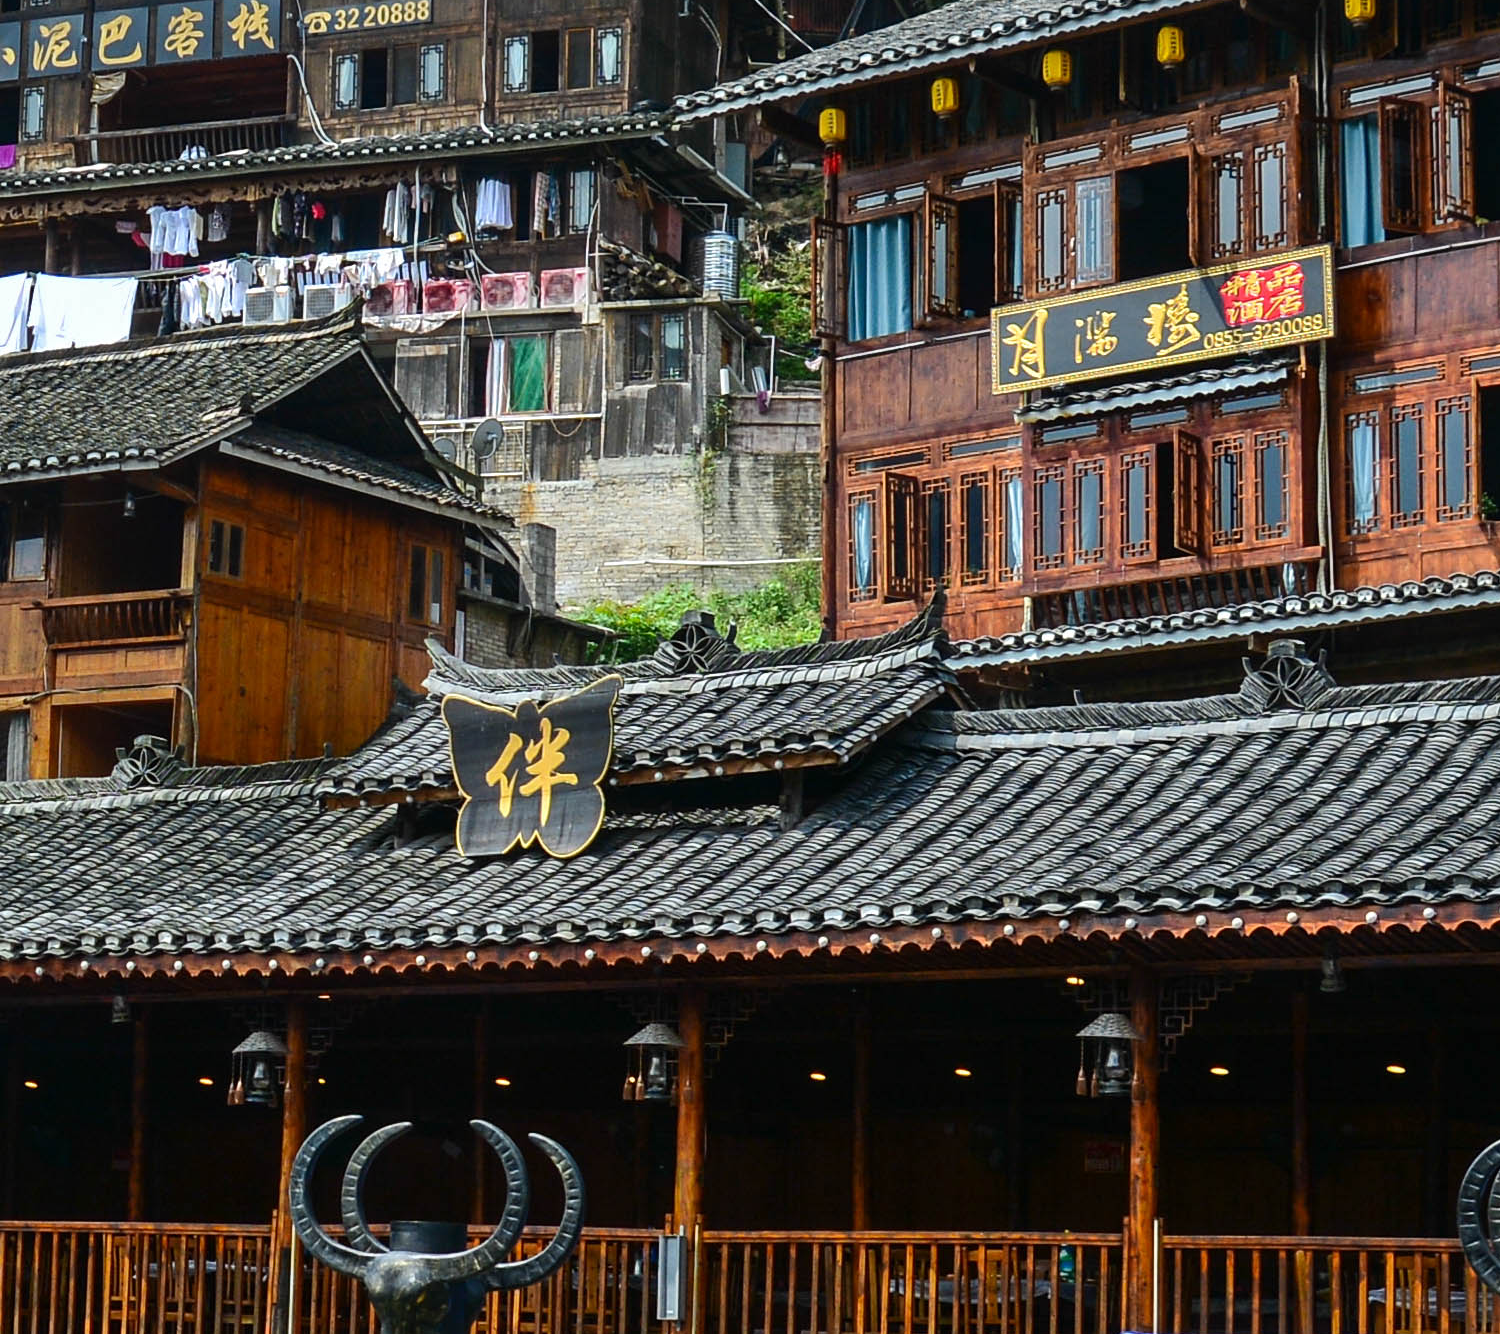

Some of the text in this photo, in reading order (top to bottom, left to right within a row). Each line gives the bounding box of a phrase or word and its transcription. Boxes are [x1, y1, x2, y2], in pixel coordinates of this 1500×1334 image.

[1220, 263, 1303, 297] 精品
[1227, 287, 1302, 323] 酒店
[1204, 314, 1323, 349] 0855-3230088
[486, 717, 578, 826] 伴
